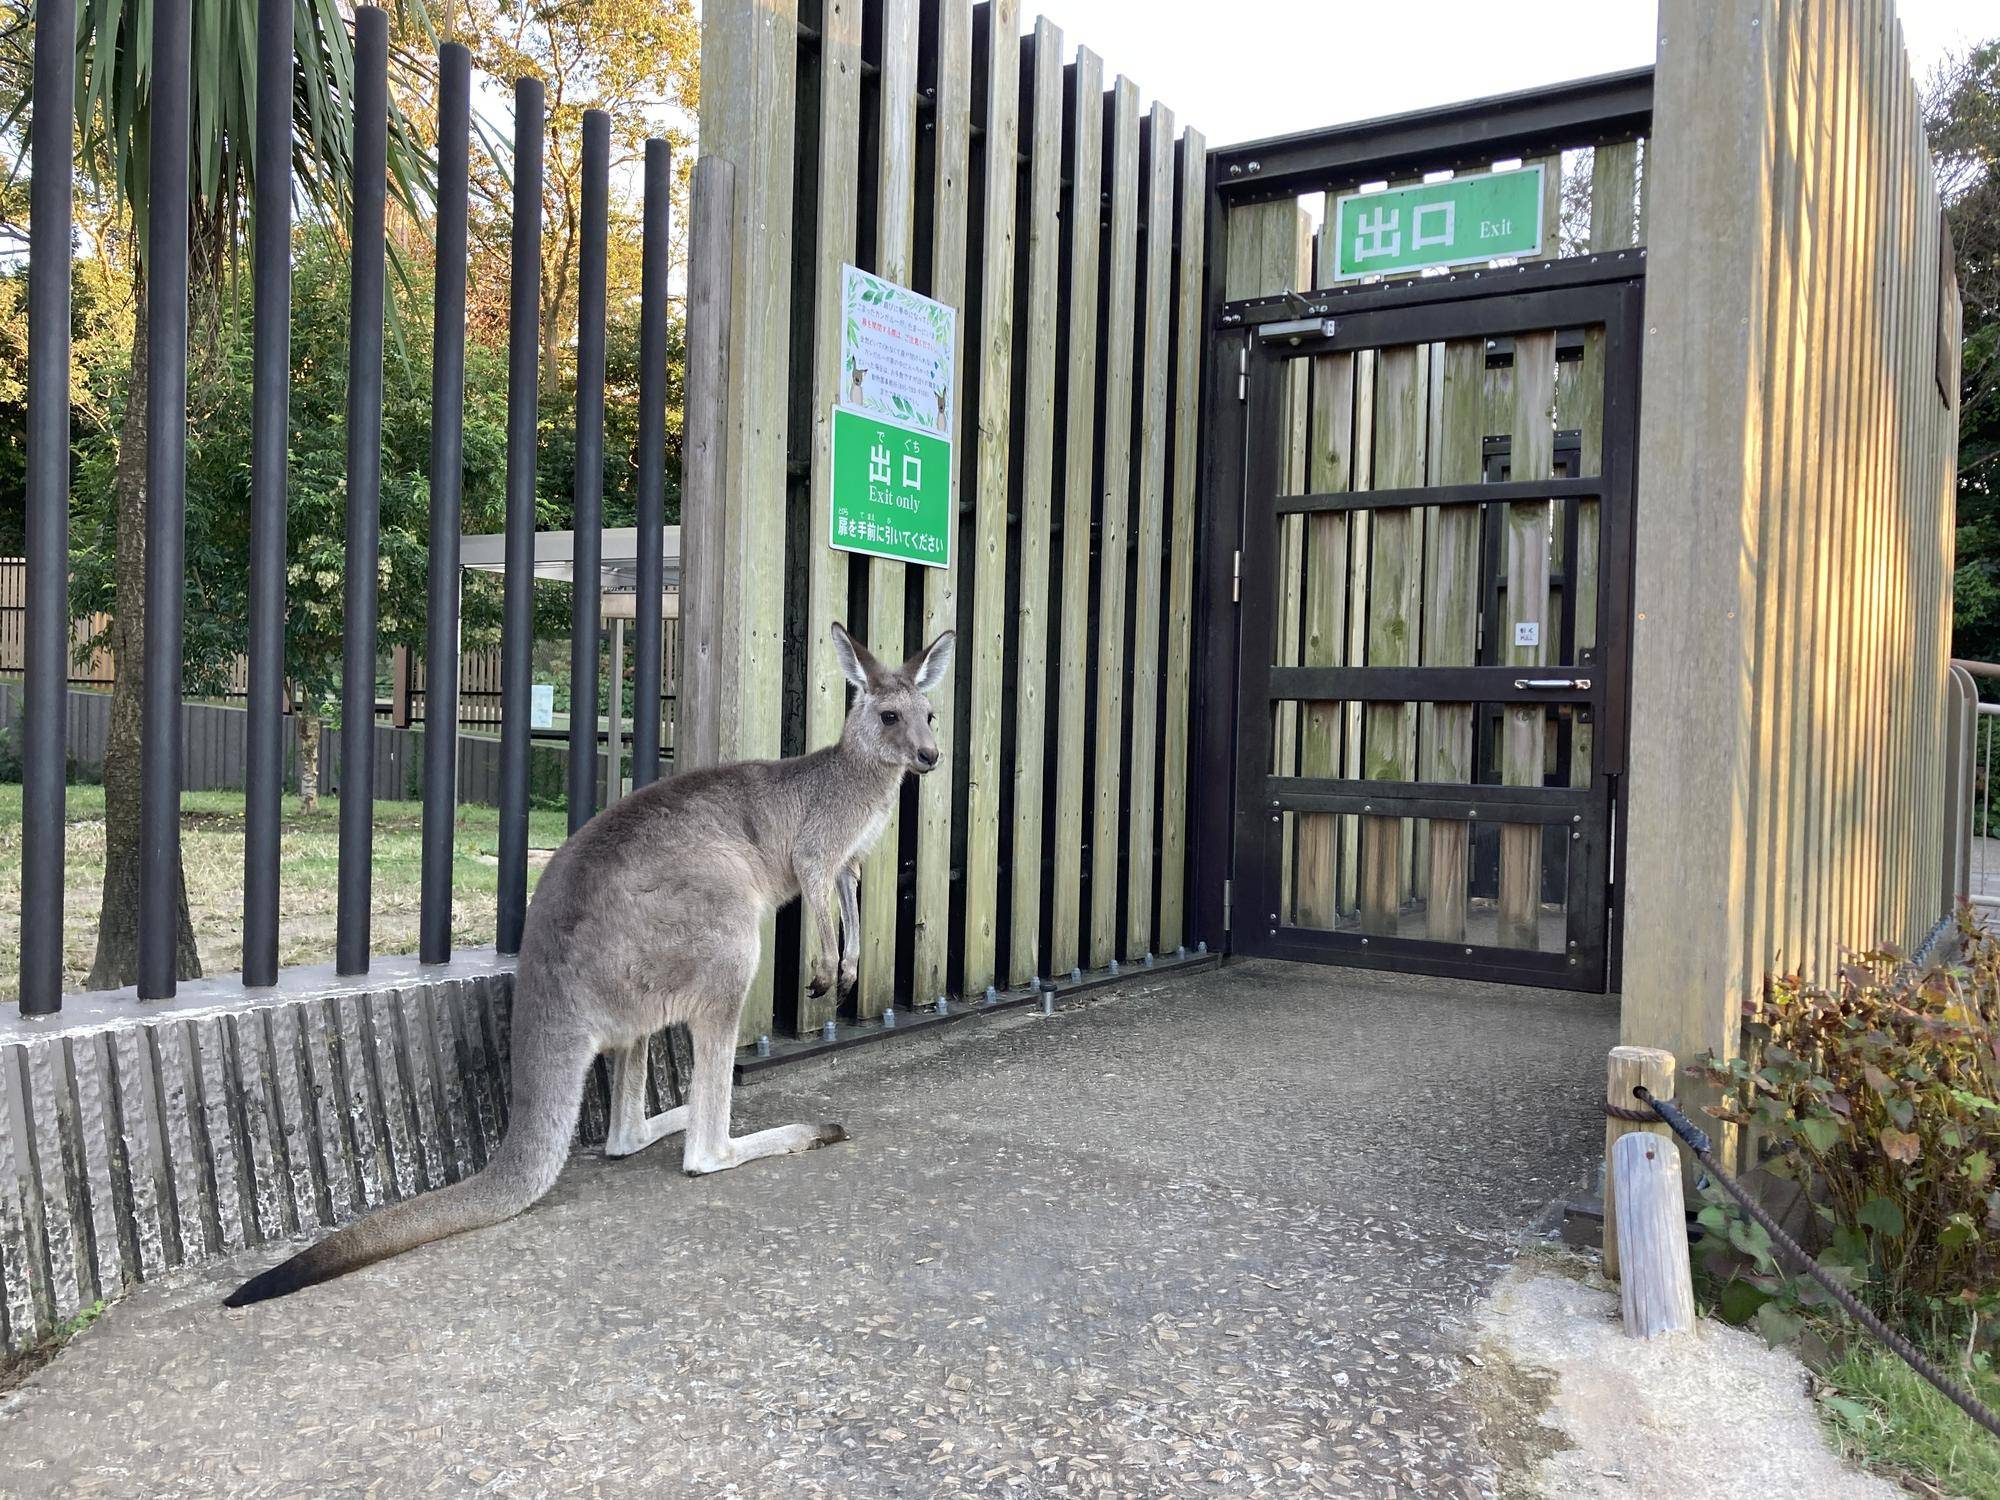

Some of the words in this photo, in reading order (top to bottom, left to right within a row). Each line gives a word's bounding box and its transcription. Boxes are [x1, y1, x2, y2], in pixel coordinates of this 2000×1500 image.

[1354, 200, 1455, 263] 出口
[1479, 218, 1513, 239] Exit
[876, 431, 885, 443] で
[904, 439, 920, 453] ぐち
[869, 444, 922, 491] 出口
[869, 485, 893, 506] Exit
[896, 492, 921, 513] only
[838, 516, 944, 553] 扉を手前に引いてください
